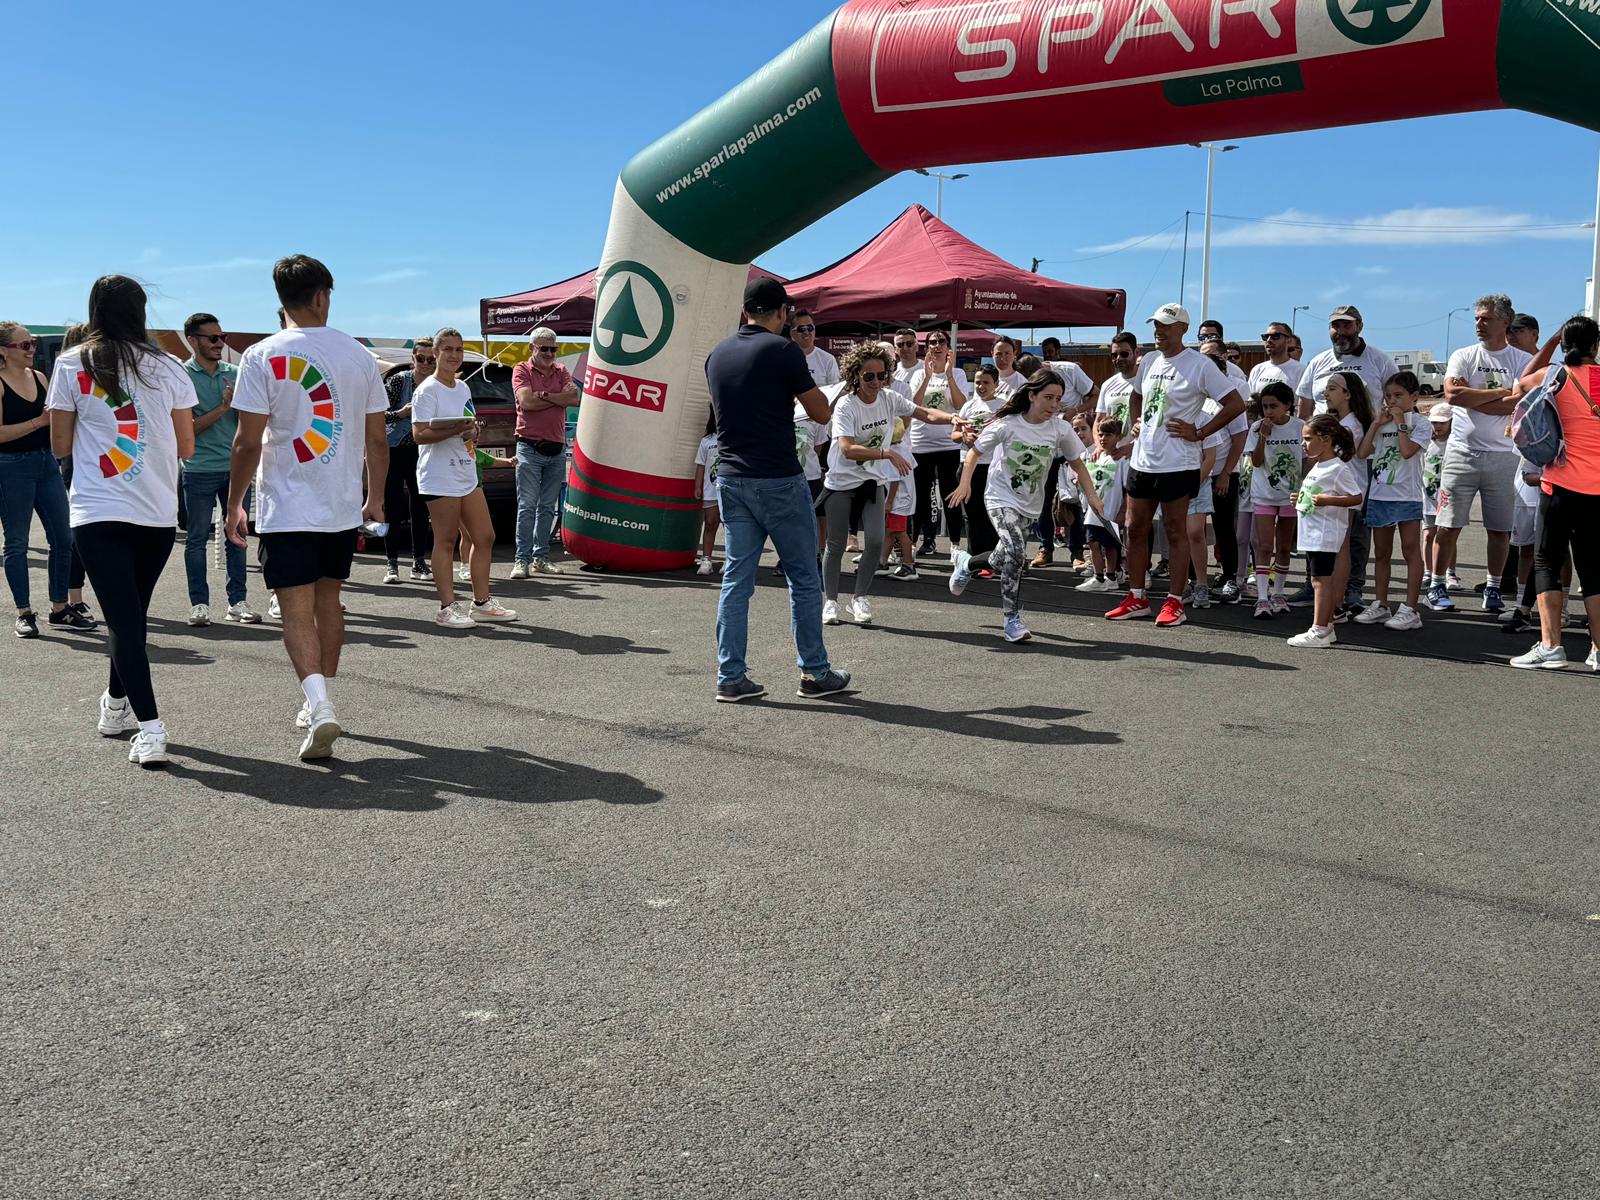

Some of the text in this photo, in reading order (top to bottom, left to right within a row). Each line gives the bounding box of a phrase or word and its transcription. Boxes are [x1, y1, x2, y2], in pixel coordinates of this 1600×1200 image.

[954, 0, 1282, 83] SPAR
[1200, 73, 1283, 98] La Palma
[655, 86, 822, 204] www.sparlapalma.com
[974, 289, 1018, 299] Ayuntamiento de
[974, 301, 1033, 311] Santa Cruz de La Palma
[496, 316, 513, 324] Santa
[583, 369, 662, 406] SPAR
[320, 421, 344, 465] MUNDO
[1022, 453, 1032, 465] 2
[1096, 470, 1103, 481] 8
[930, 481, 938, 523] didas
